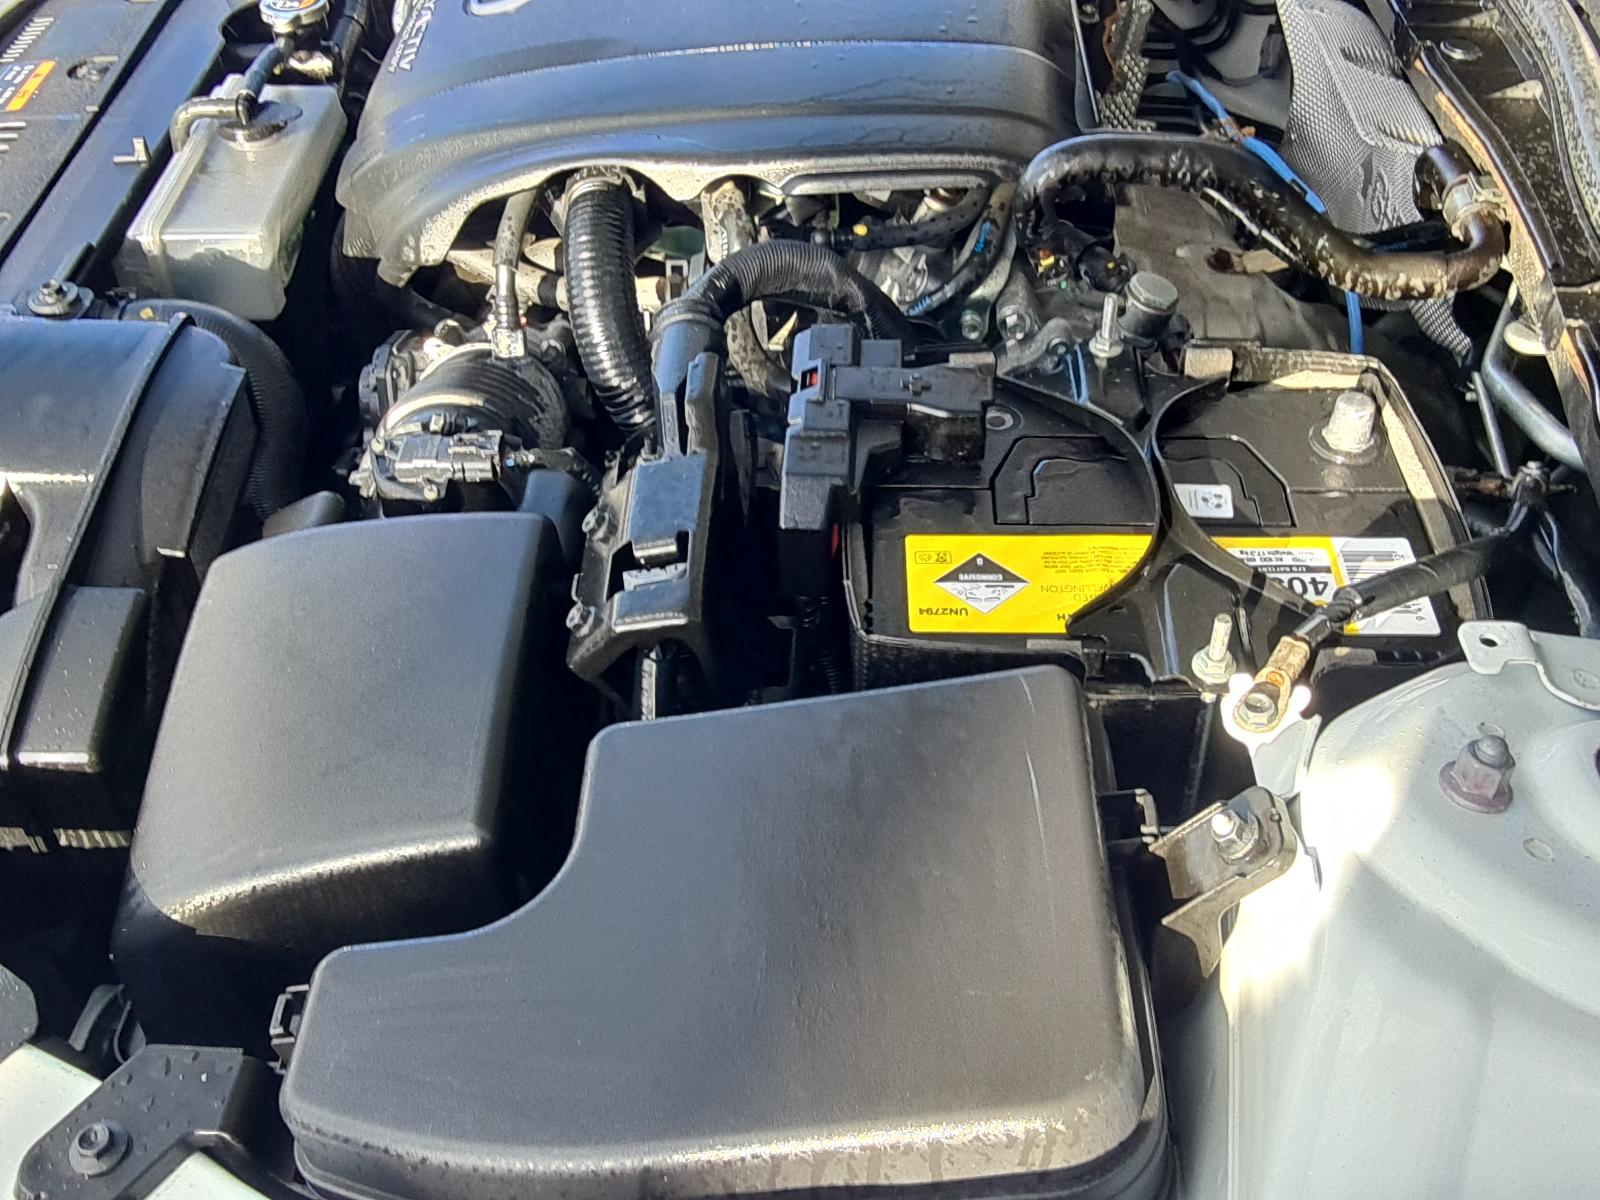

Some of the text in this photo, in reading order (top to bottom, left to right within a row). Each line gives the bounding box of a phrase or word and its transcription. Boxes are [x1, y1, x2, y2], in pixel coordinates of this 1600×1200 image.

[958, 573, 1003, 581] CORROSIVE
[1041, 583, 1114, 593] WELLINGTON
[919, 607, 969, 617] UN2794
